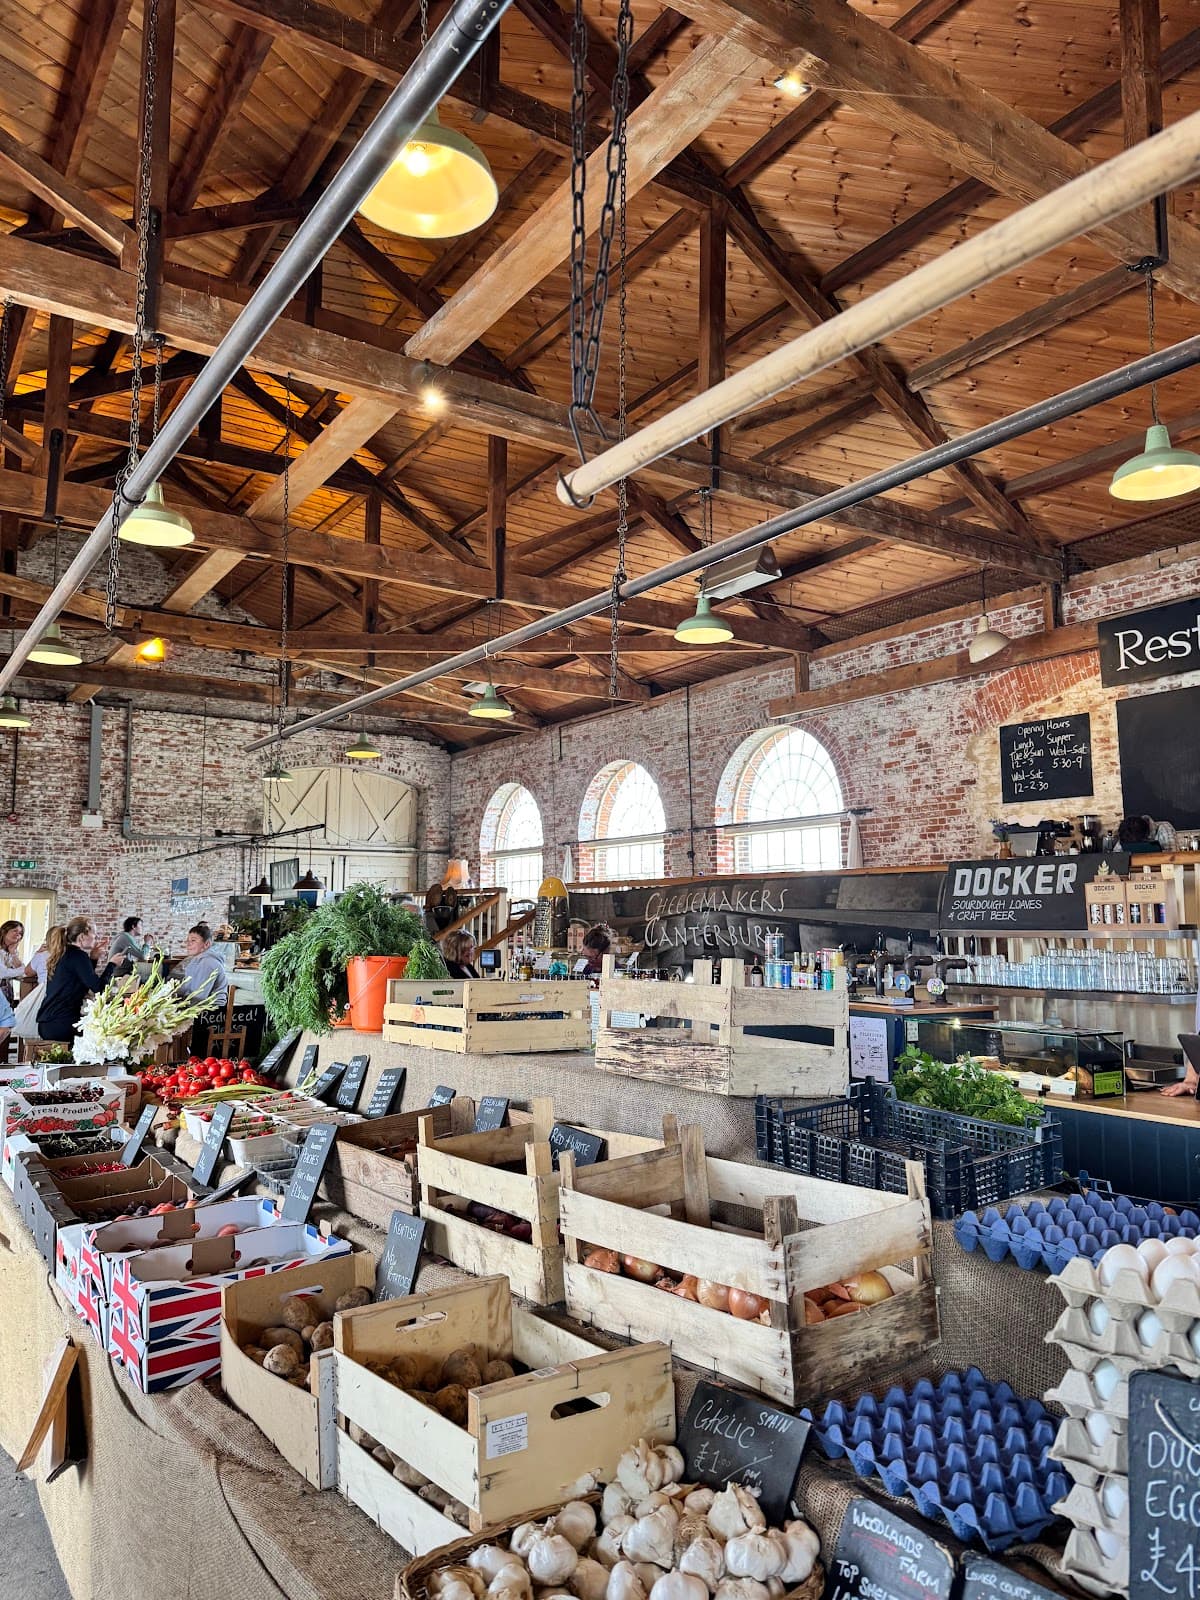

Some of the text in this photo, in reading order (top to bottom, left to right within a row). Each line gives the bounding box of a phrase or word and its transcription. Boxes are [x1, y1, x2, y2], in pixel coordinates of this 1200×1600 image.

[1017, 720, 1070, 738] Opening Hours
[1013, 737, 1035, 750] Lunch
[1046, 733, 1075, 746] Supper
[952, 863, 1077, 897] DOCKER
[1133, 883, 1157, 891] DOCKER
[951, 900, 1042, 910] SOURDOUGH LOAVES
[957, 911, 986, 921] CRAFT
[990, 911, 1017, 921] BEER
[200, 1007, 258, 1025] Redced!
[31, 1104, 99, 1117] Fresh Produce
[550, 1127, 565, 1146] RED
[570, 1136, 591, 1156] WHITE
[694, 1399, 755, 1449] GARLIC
[758, 1411, 794, 1433] SPAIN
[852, 1508, 923, 1558] WOODLANDS
[899, 1556, 940, 1594] FARM
